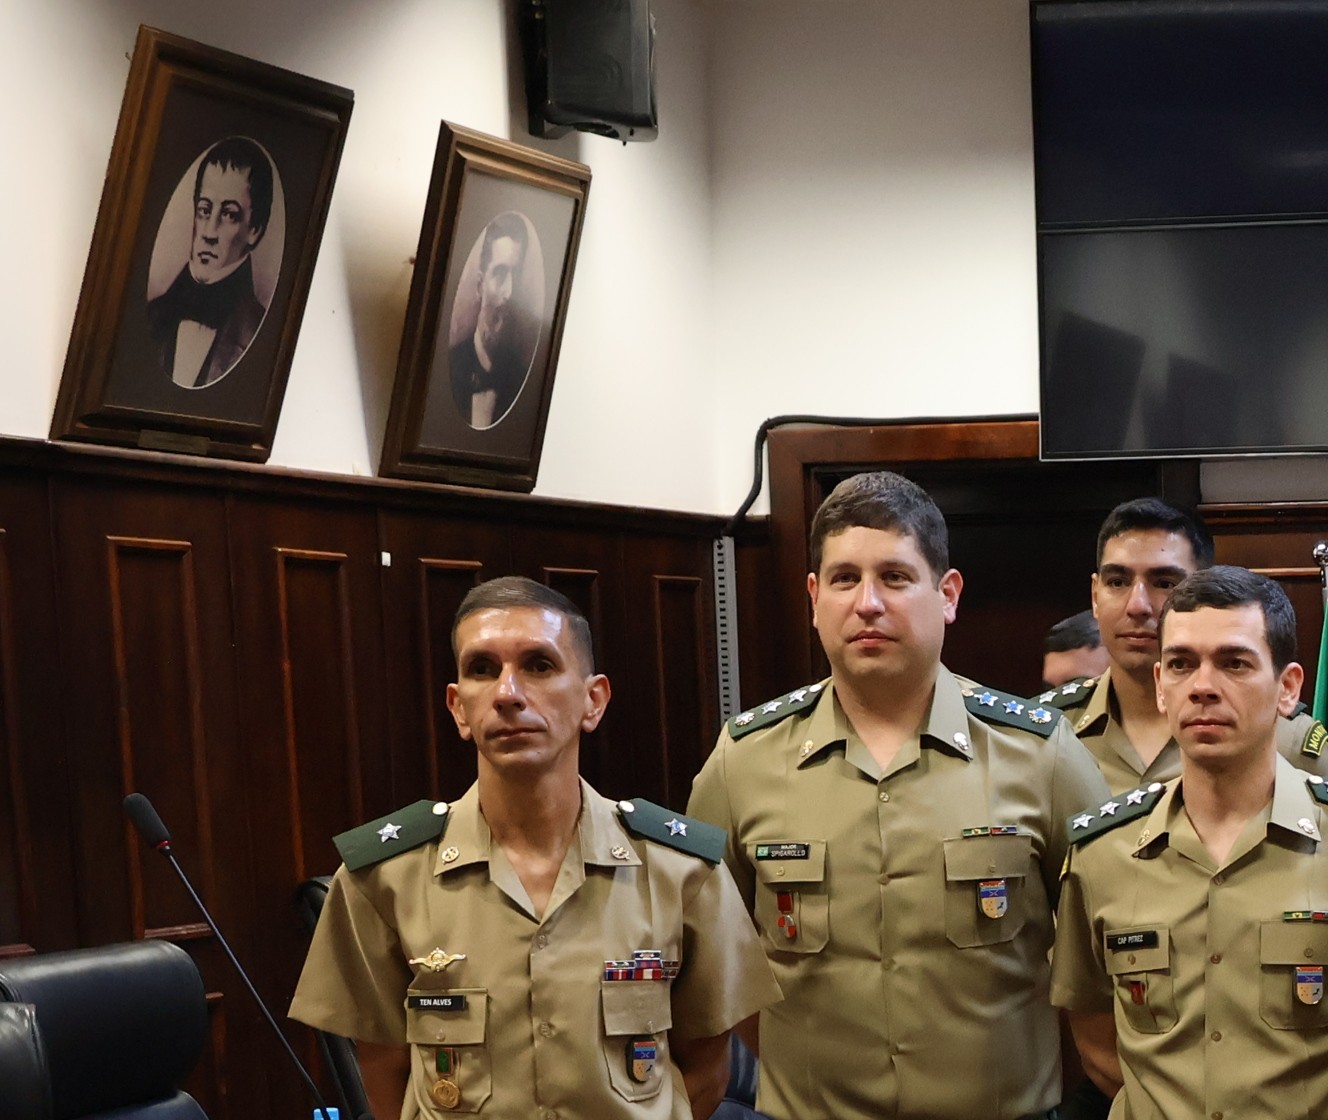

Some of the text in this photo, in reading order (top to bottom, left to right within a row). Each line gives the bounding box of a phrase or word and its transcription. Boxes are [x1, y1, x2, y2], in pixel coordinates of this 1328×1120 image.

[1117, 936, 1128, 945] CAP
[419, 998, 452, 1006] TEN ALVES
